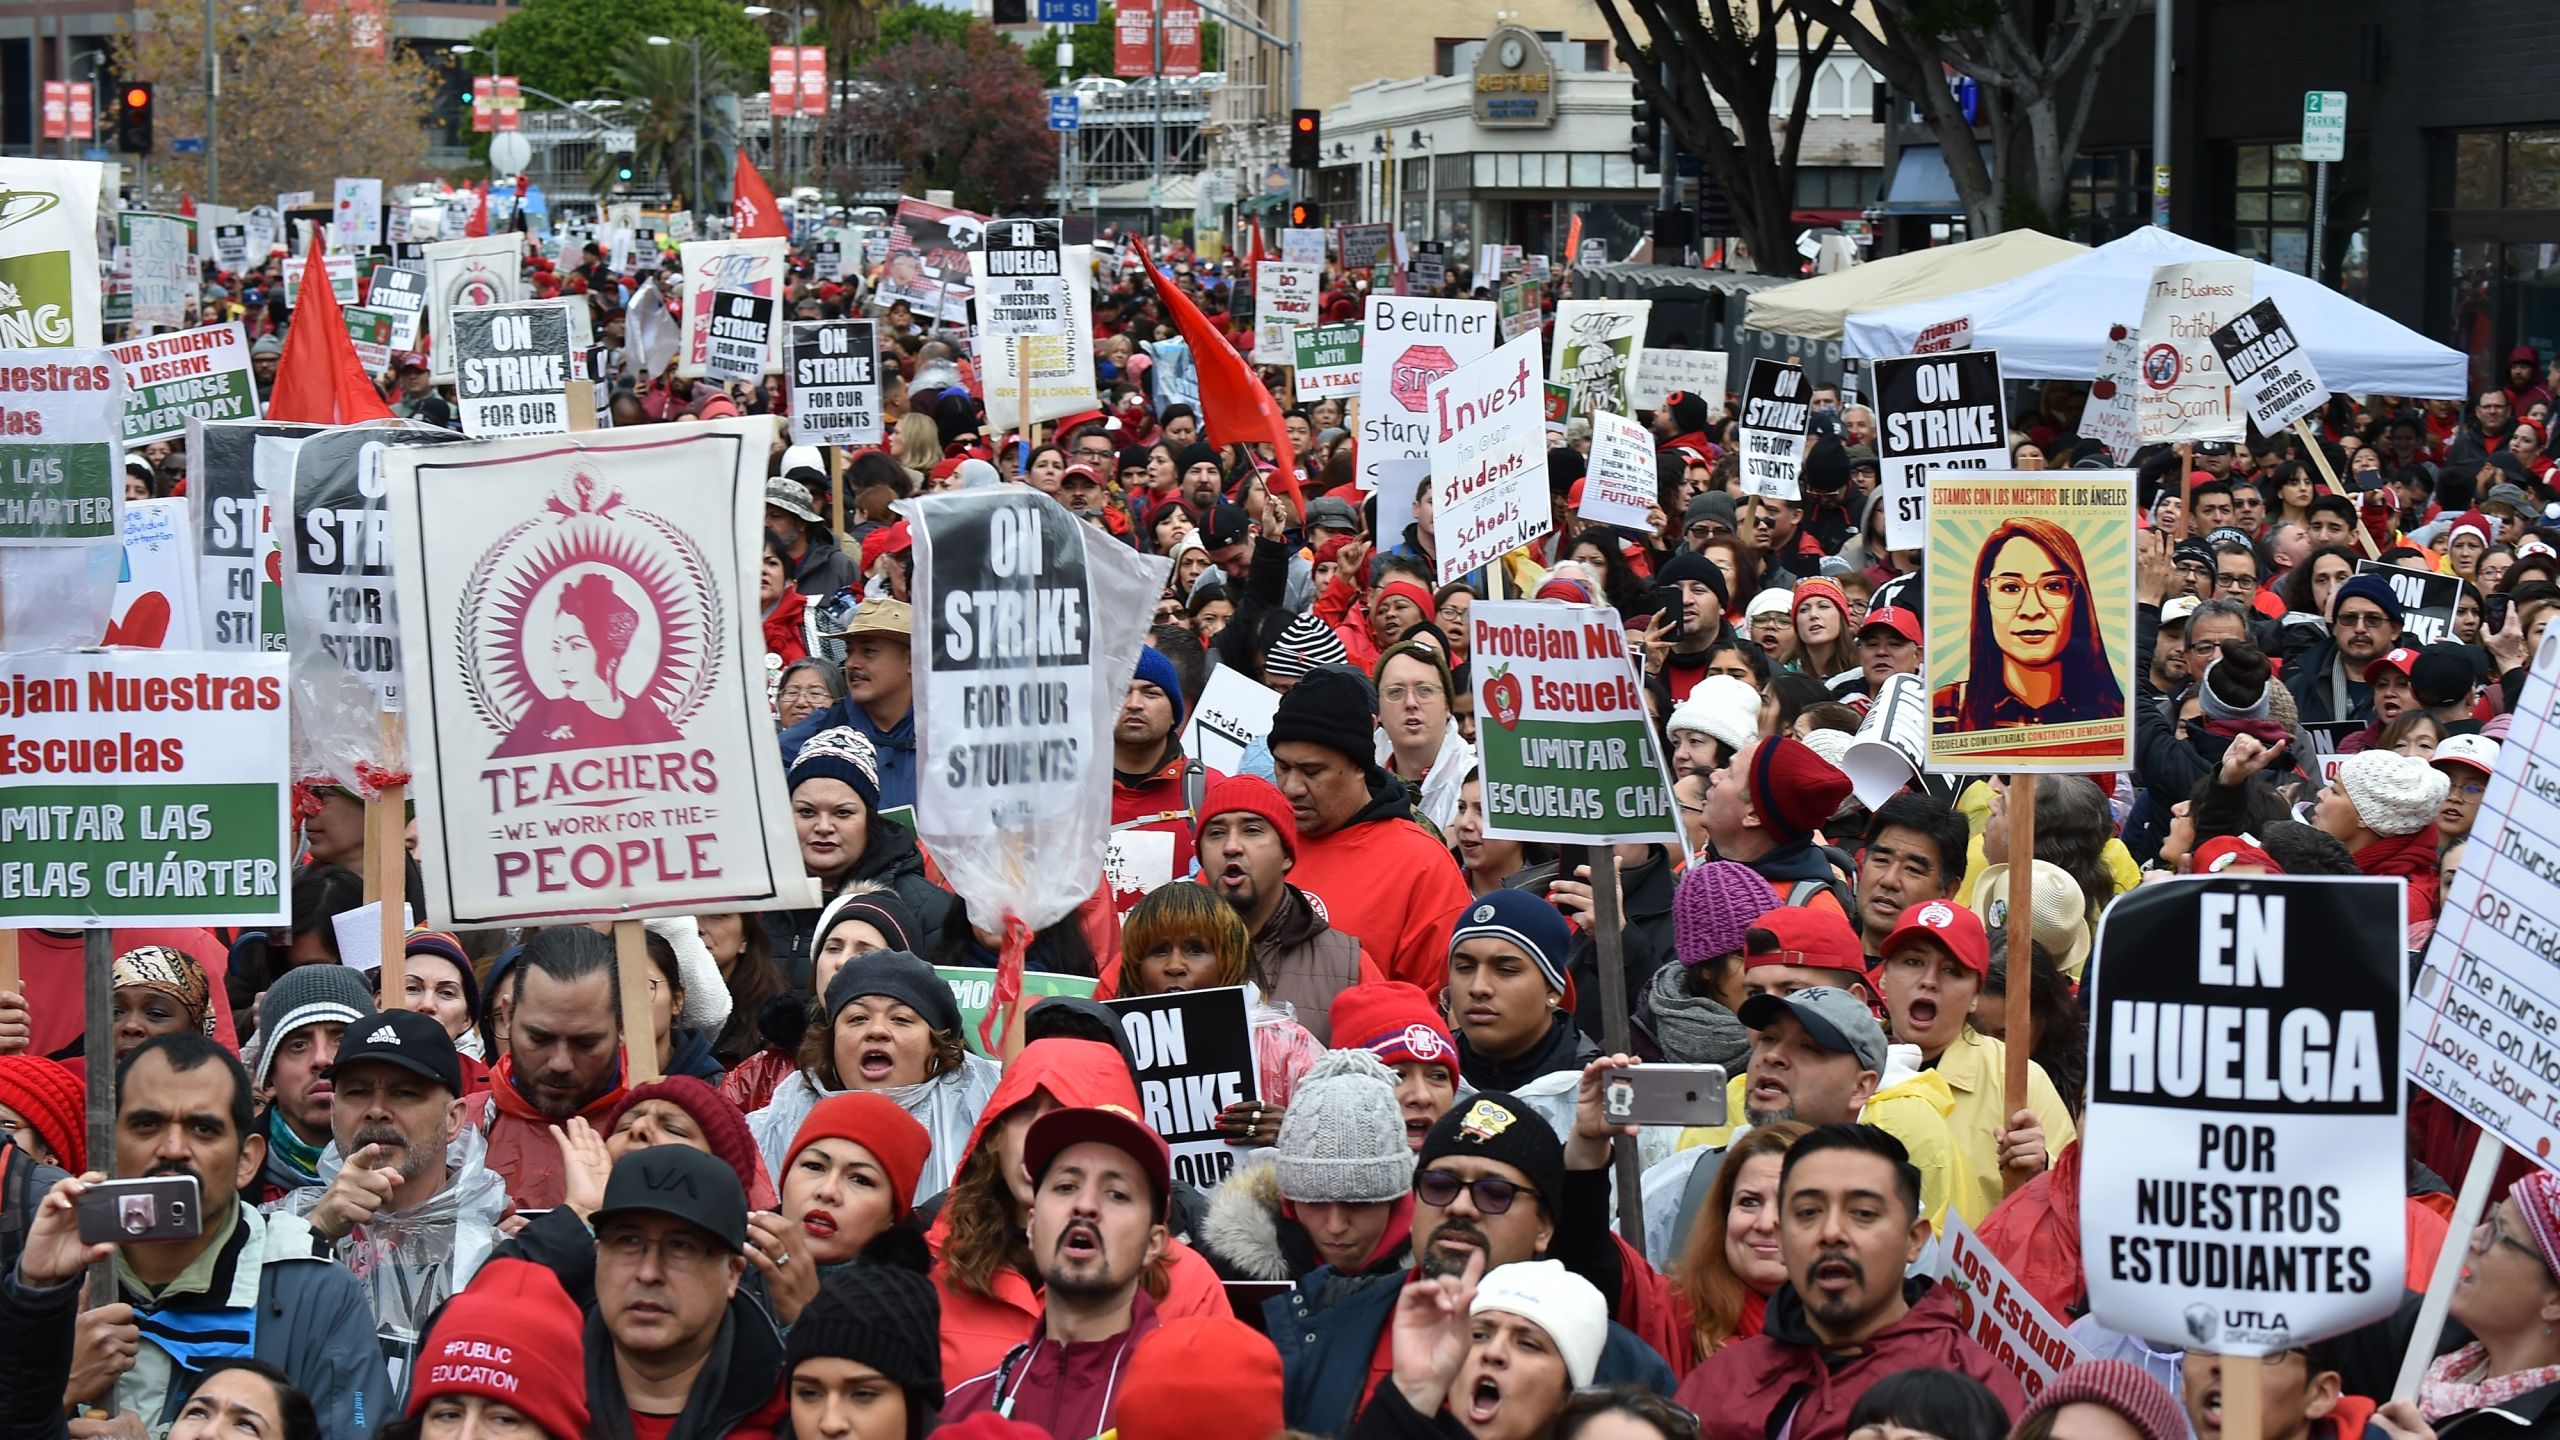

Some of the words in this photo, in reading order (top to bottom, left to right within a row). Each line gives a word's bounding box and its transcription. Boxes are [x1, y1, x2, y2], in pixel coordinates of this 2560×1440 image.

[1045, 2, 1064, 18] 1st
[1072, 4, 1091, 17] St
[2310, 95, 2319, 110] 2
[2305, 116, 2342, 128] PARKING
[1012, 223, 1035, 247] EN
[989, 250, 1058, 275] HUELGA
[389, 271, 412, 291] ON
[1015, 279, 1034, 291] POR
[2155, 280, 2177, 299] The
[2181, 277, 2235, 300] Business
[372, 288, 421, 312] STRIKE
[731, 297, 753, 318] ON
[993, 307, 1057, 321] ESTUDIANTES
[1001, 293, 1050, 306] NUESTROS
[712, 316, 767, 343] STRIKE
[1376, 301, 1488, 335] Beutner
[1920, 317, 1968, 341] STUDENTS
[2231, 314, 2261, 345] EN
[148, 328, 235, 359] STUDENTS
[491, 316, 532, 351] ON
[818, 328, 848, 356] ON
[1296, 332, 1315, 348] WE
[1318, 328, 1359, 346] STAND
[716, 341, 735, 354] FOR
[736, 345, 757, 359] OUR
[1314, 348, 1346, 365] WITH
[2105, 352, 2118, 365] to
[2115, 341, 2134, 357] my
[2180, 352, 2193, 373] is
[2199, 354, 2213, 373] a
[2225, 326, 2295, 382] HUELGA
[140, 354, 211, 384] DESERVE
[464, 354, 566, 394] STRIKE
[710, 355, 759, 374] STUDENTS
[798, 356, 872, 385] STRIKE
[1560, 353, 1628, 385] STARVING
[2260, 364, 2282, 385] POR
[131, 393, 149, 411] A
[155, 373, 231, 406] NURSE
[1301, 376, 1319, 389] LA
[1774, 369, 1802, 398] ON
[1916, 363, 1960, 404] ON
[2255, 368, 2304, 405] NUESTROS
[809, 391, 834, 409] FOR
[837, 389, 863, 407] OUR
[1436, 358, 1530, 443] Invest
[2257, 379, 2316, 421] ESTUDIANTES
[123, 395, 243, 437] EVERYDAY
[480, 404, 509, 427] FOR
[520, 401, 557, 425] OUR
[803, 411, 870, 429] STUDENTS
[1745, 397, 1808, 431] STRIKE
[1887, 405, 1998, 451] STRIKE
[2097, 411, 2131, 429] NOW
[1456, 443, 1475, 467] in
[1479, 423, 1511, 451] our
[1605, 434, 1616, 443] MY
[1621, 425, 1647, 443] MISS
[1750, 435, 1769, 453] FOR
[1770, 437, 1793, 457] OUR
[1601, 458, 1623, 468] THEM
[1612, 448, 1632, 459] BUT
[13, 459, 64, 484] LAS
[1600, 469, 1625, 480] MUCH
[1627, 475, 1637, 483] TO
[1473, 488, 1496, 512] and
[1623, 484, 1638, 493] FOR
[1933, 488, 1972, 505] ESTAMOS
[1974, 488, 1991, 505] CON
[1993, 488, 2010, 505] LOS
[2012, 488, 2057, 505] MAESTROS
[2059, 488, 2070, 506] DE
[2072, 488, 2088, 506] LOS
[2091, 485, 2127, 506] ÁNGELES
[126, 532, 174, 546] attention
[990, 507, 1043, 578] ON
[1444, 533, 1514, 583] Future
[1518, 519, 1550, 541] Now
[328, 586, 382, 625] FOR
[2389, 573, 2427, 610] ON
[944, 587, 1082, 662] STRIKE
[1475, 619, 1580, 663] Protejan
[87, 671, 282, 713] Nuestras
[963, 684, 1011, 729] FOR
[1018, 681, 1068, 725] OUR
[1932, 737, 1968, 751] ESCUELAS
[1970, 733, 2025, 748] COMUNITARIAS
[2027, 730, 2075, 743] CONSTRUYEN
[2076, 723, 2125, 738] DEMOCRACIA
[0, 732, 184, 775] Escuelas
[946, 738, 1078, 790] STUDENTS
[1520, 737, 1630, 771] LIMITAR
[480, 747, 720, 816] TEACHERS
[1487, 781, 1605, 820] ESCUELAS
[2, 804, 126, 842] MITAR
[140, 804, 213, 841] LAS
[504, 822, 538, 842] WE
[545, 813, 612, 838] WORK
[615, 810, 656, 833] FOR
[661, 805, 703, 827] THE
[2, 861, 91, 899] ELAS
[105, 851, 278, 898] CHÁRTER
[493, 832, 724, 898] PEOPLE
[2477, 892, 2511, 931] OR
[2199, 892, 2286, 989] EN
[2458, 952, 2494, 996] The
[2497, 984, 2557, 1036] nurse
[2442, 985, 2493, 1038] here
[2496, 1030, 2525, 1063] on
[366, 1034, 401, 1045] adidas
[1120, 1006, 1188, 1072] ON
[2108, 999, 2384, 1103] HUELGA
[2431, 1023, 2482, 1080] Love,
[2421, 1062, 2445, 1089] P.S.
[2449, 1078, 2467, 1104] I'm
[2469, 1096, 2512, 1133] sorry!
[2198, 1123, 2276, 1174] POR
[2136, 1178, 2341, 1235] NUESTROS
[2109, 1234, 2371, 1295] ESTUDIANTES
[2224, 1309, 2289, 1331] UTLA
[444, 1340, 512, 1364] #PUBLIC
[431, 1364, 519, 1393] EDUCATION
